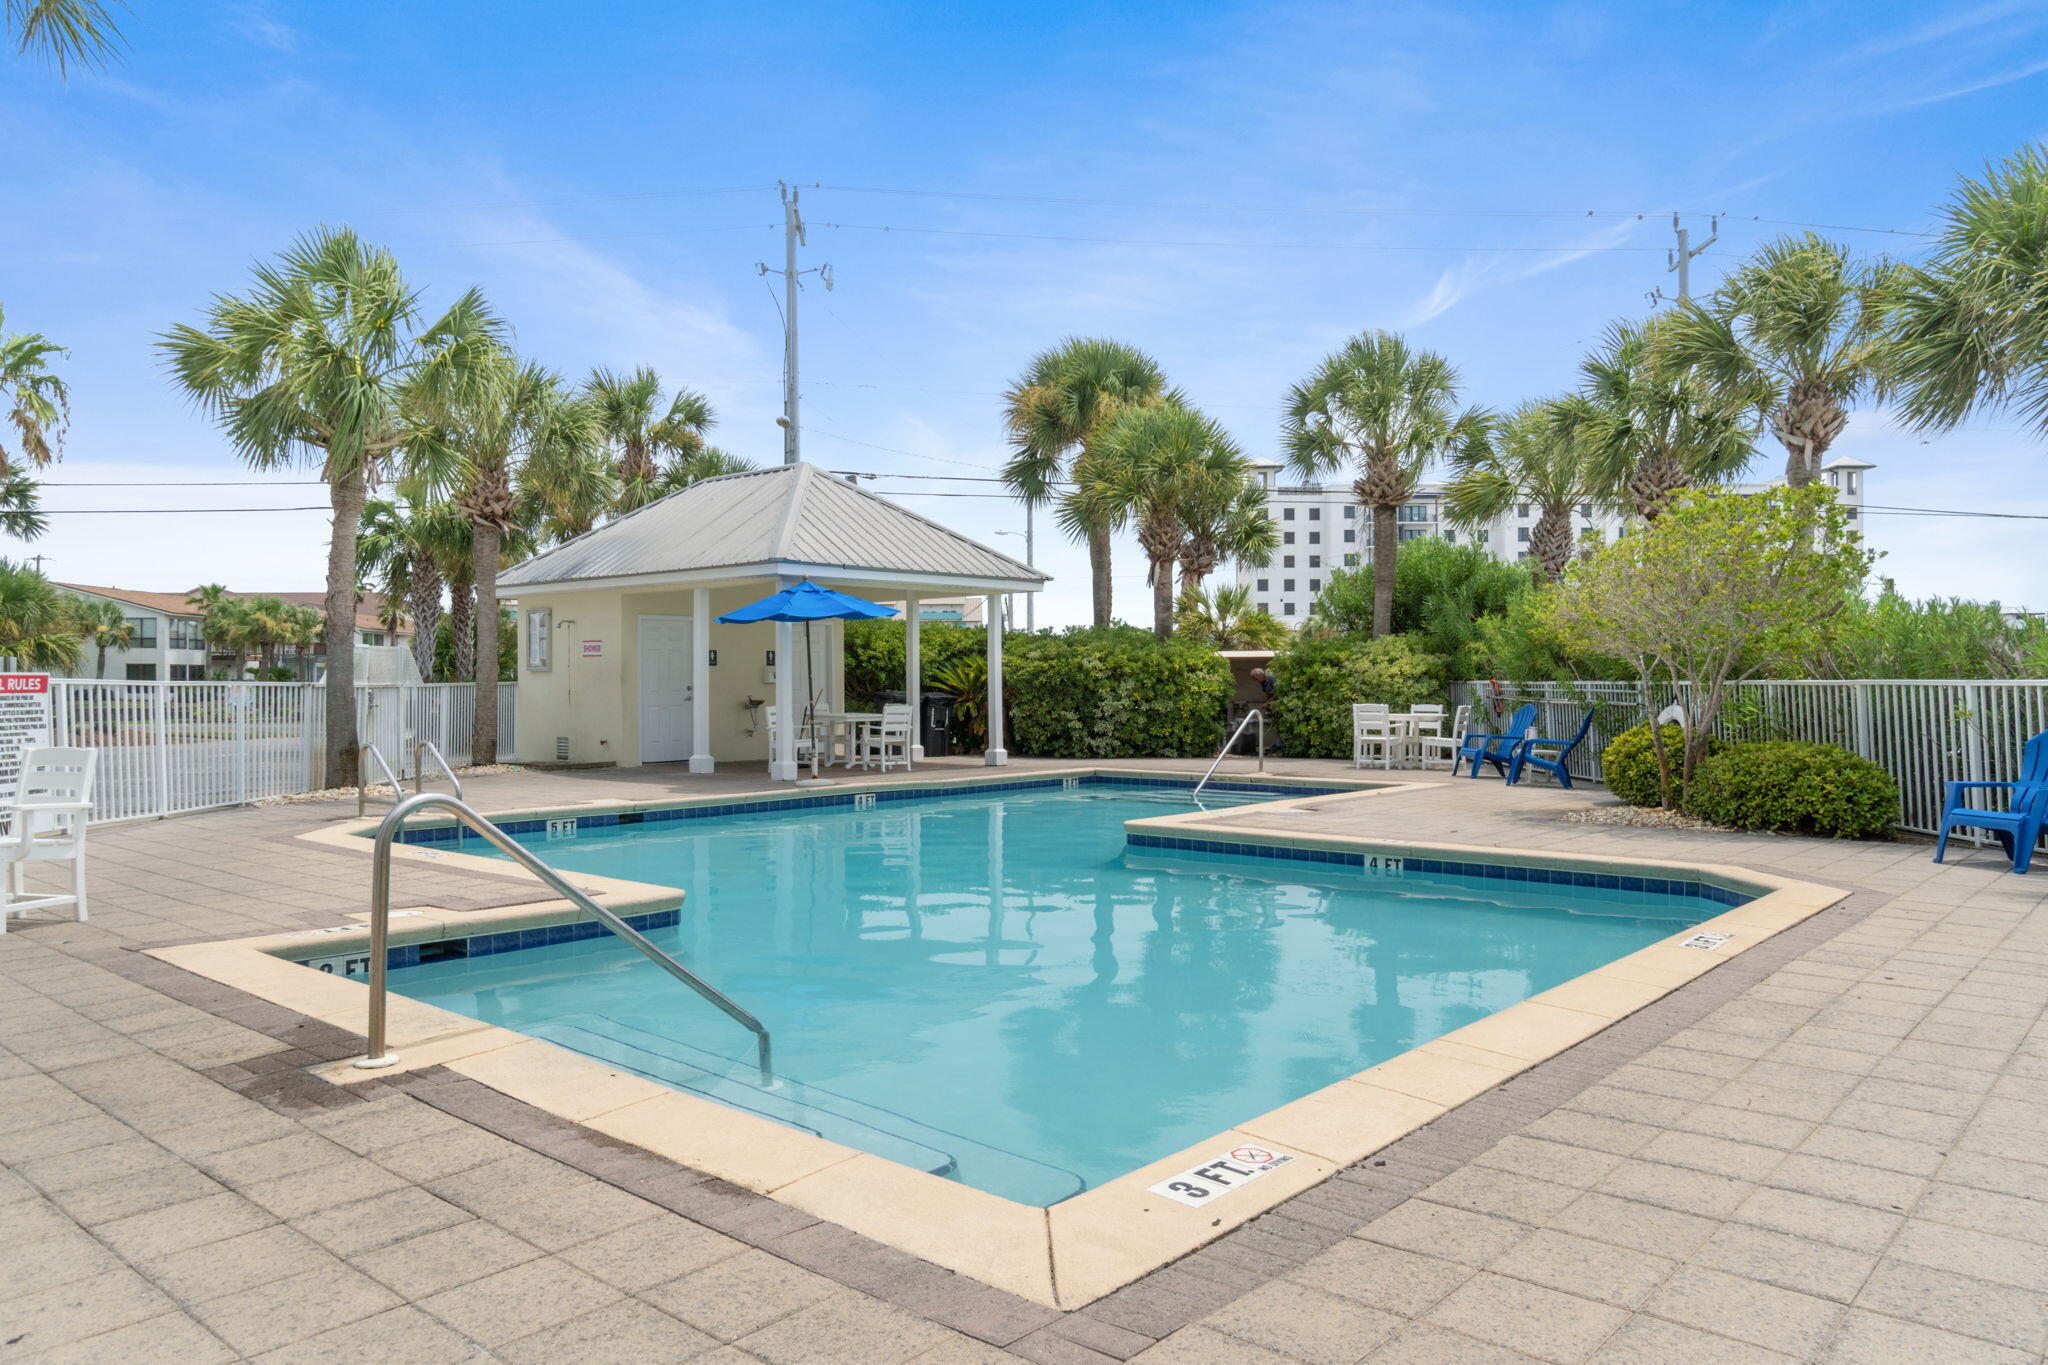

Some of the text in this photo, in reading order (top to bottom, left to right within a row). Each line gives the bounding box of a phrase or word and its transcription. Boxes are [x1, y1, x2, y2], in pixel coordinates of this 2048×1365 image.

[8, 678, 41, 690] RULES
[858, 795, 875, 804] 4 FT
[551, 820, 576, 831] 5 FT
[1370, 856, 1402, 870] 4 FT
[1267, 1154, 1294, 1167] DIVING
[1168, 1181, 1210, 1198] 3
